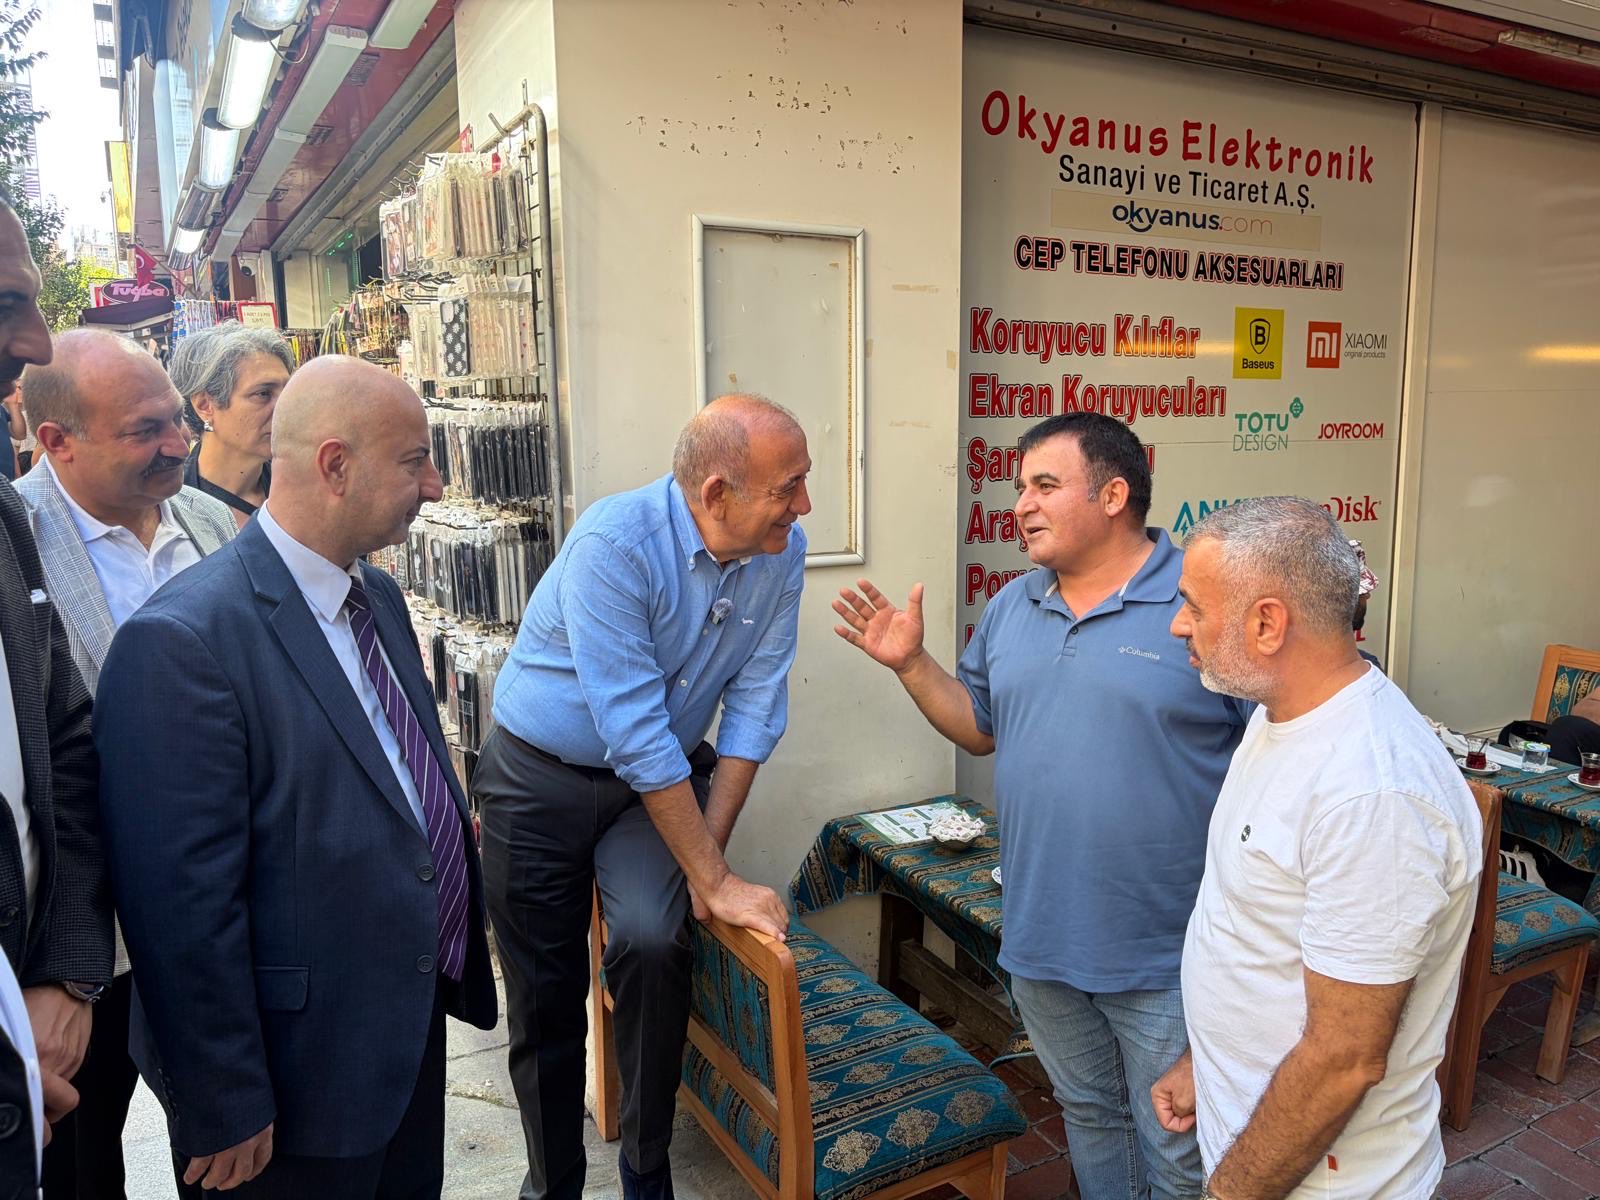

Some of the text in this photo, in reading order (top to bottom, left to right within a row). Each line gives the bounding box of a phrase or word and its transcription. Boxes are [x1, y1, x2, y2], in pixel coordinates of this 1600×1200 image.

[981, 89, 1374, 184] Okyanus Elektronik
[1059, 154, 1315, 214] Sanayi ve Ticaret A.Ş.
[1112, 200, 1273, 235] okyanus.com
[1014, 235, 1344, 291] CEP TELEFONU AKSESUARLARI
[970, 308, 1200, 363] Koruyucu Kılıflar
[1344, 332, 1388, 349] XIAOMI
[1241, 358, 1275, 370] Baseus
[1344, 350, 1386, 359] original products
[969, 373, 1227, 425] Ekran Koruyucuları
[1235, 412, 1289, 434] TOTU
[1318, 423, 1384, 440] JOYROOM
[1232, 434, 1289, 452] DESIGN
